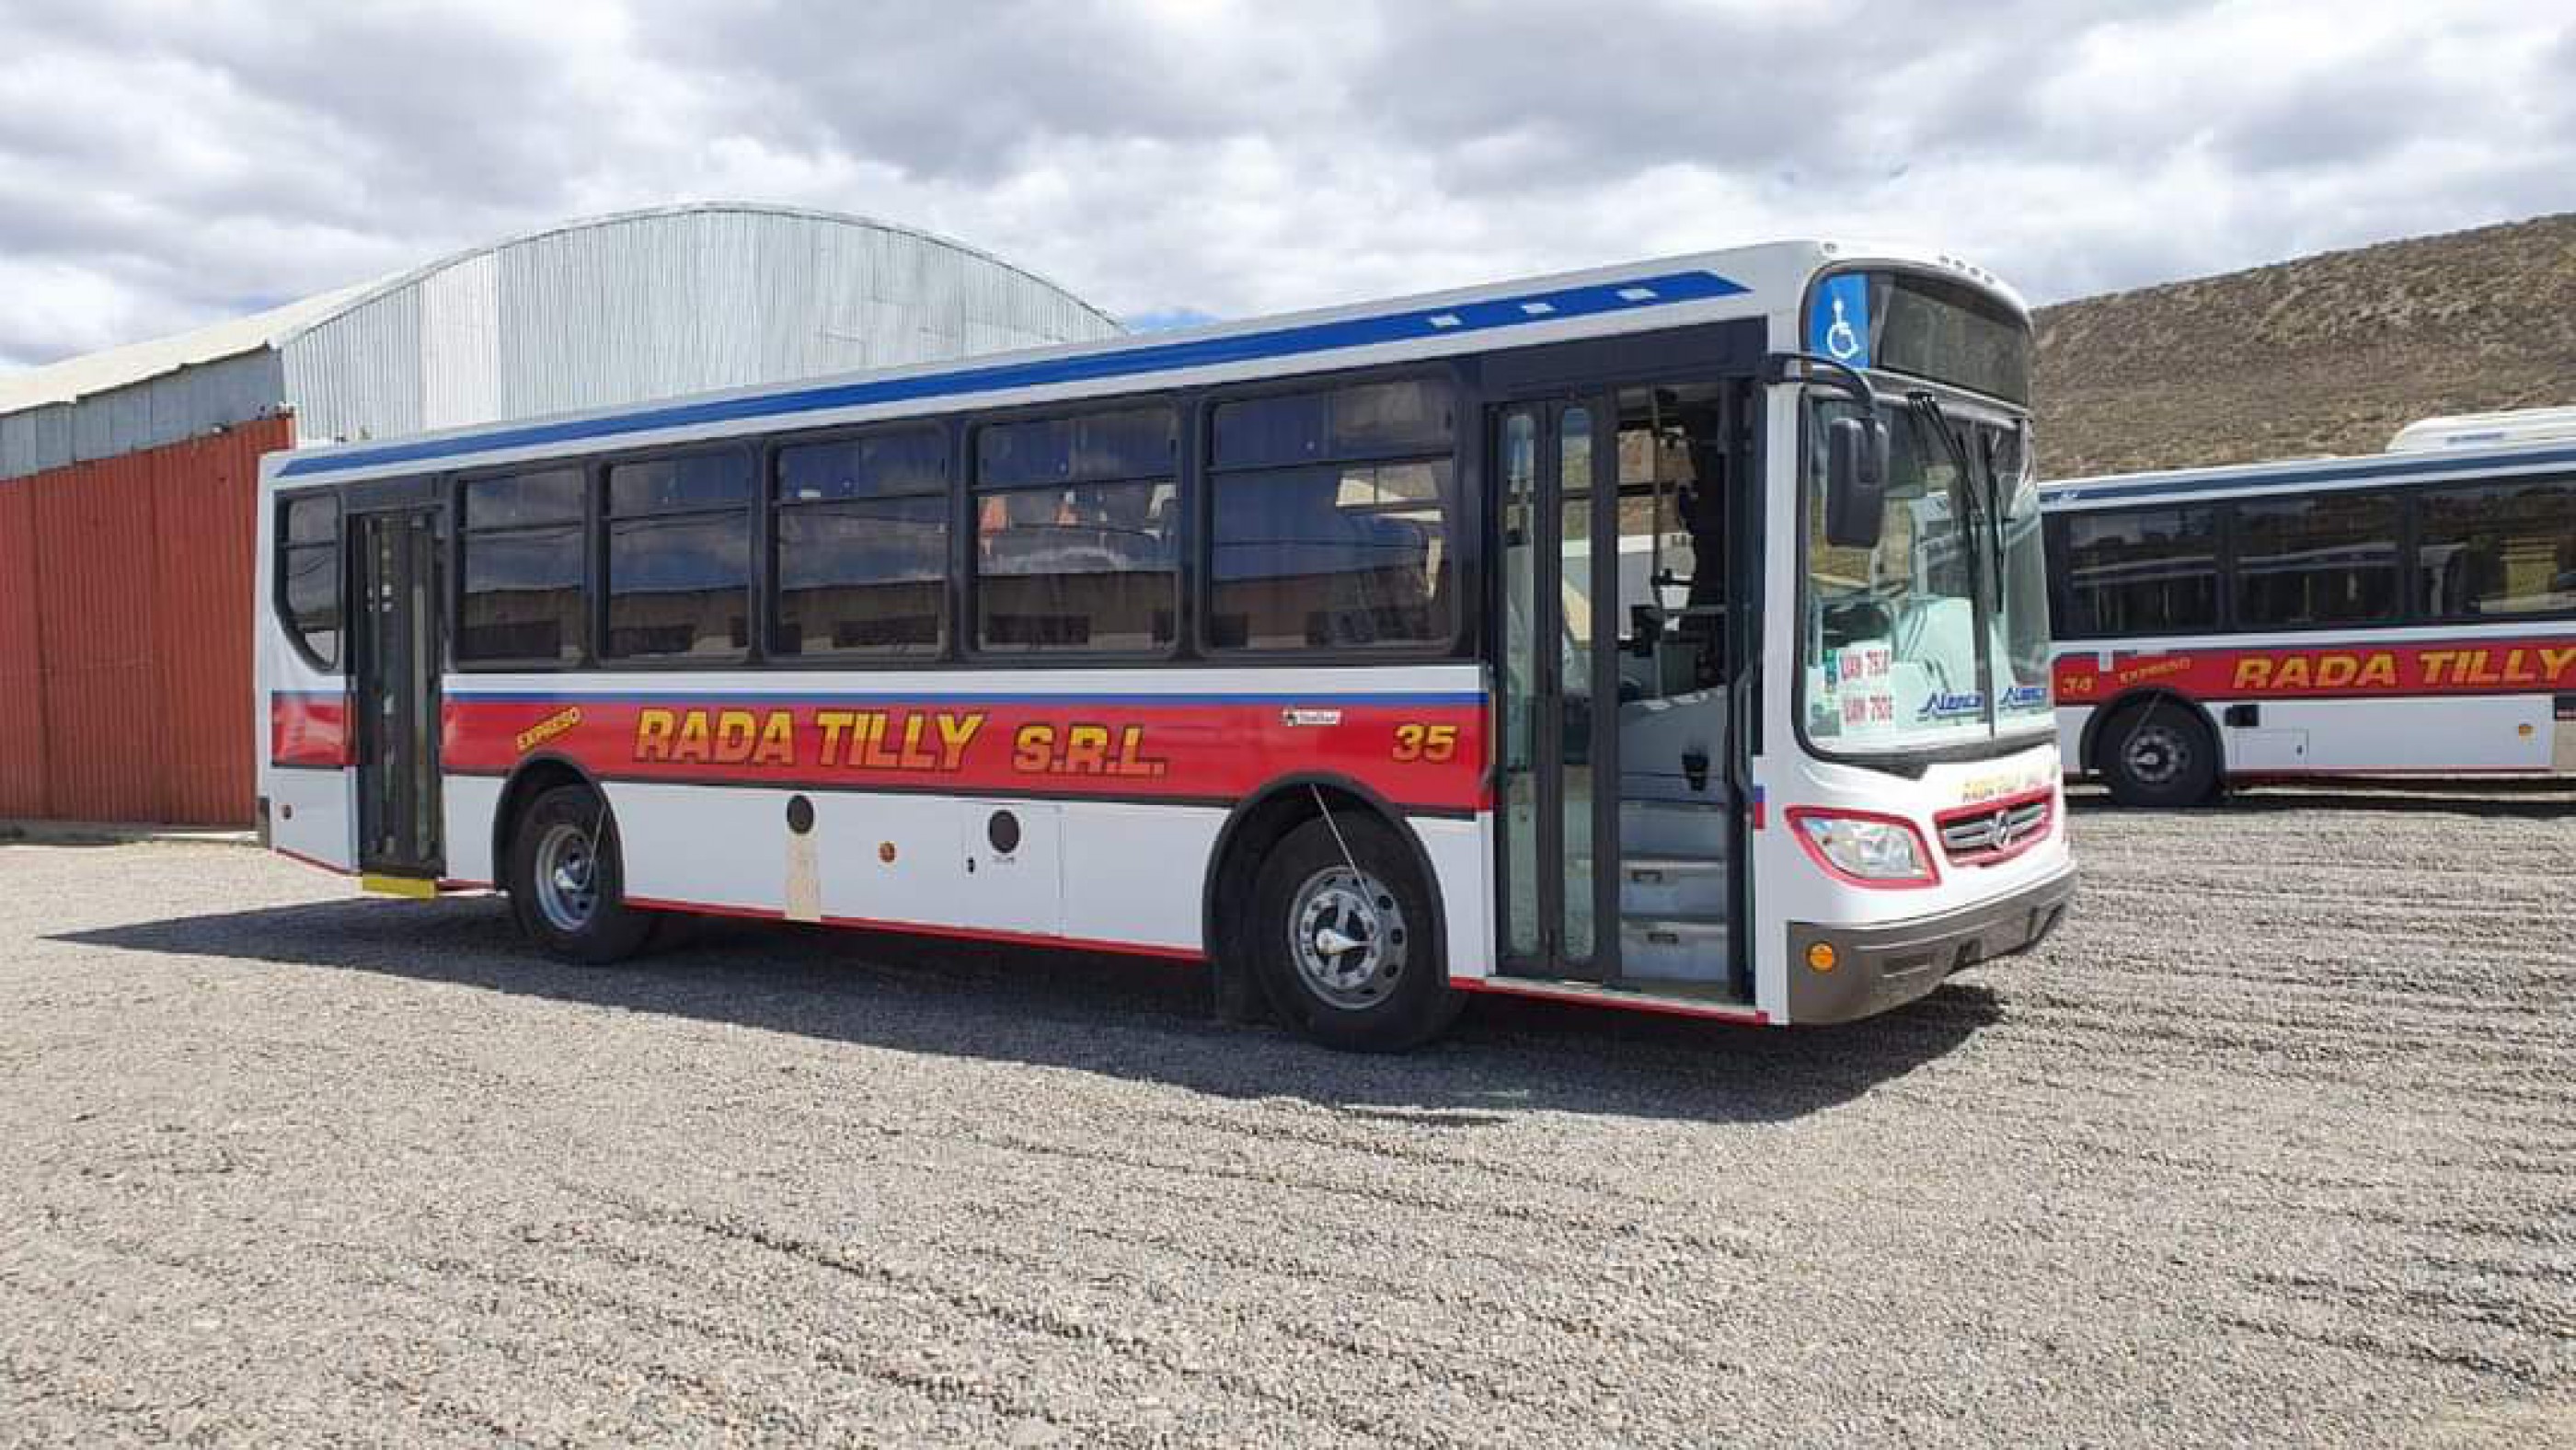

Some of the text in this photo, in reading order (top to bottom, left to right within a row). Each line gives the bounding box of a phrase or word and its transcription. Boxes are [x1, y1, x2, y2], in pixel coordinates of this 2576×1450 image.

[2233, 648, 2576, 689] RADA TILLY
[635, 708, 1165, 776] RADA TILLY S.R.L.
[1392, 723, 1458, 762] 35
